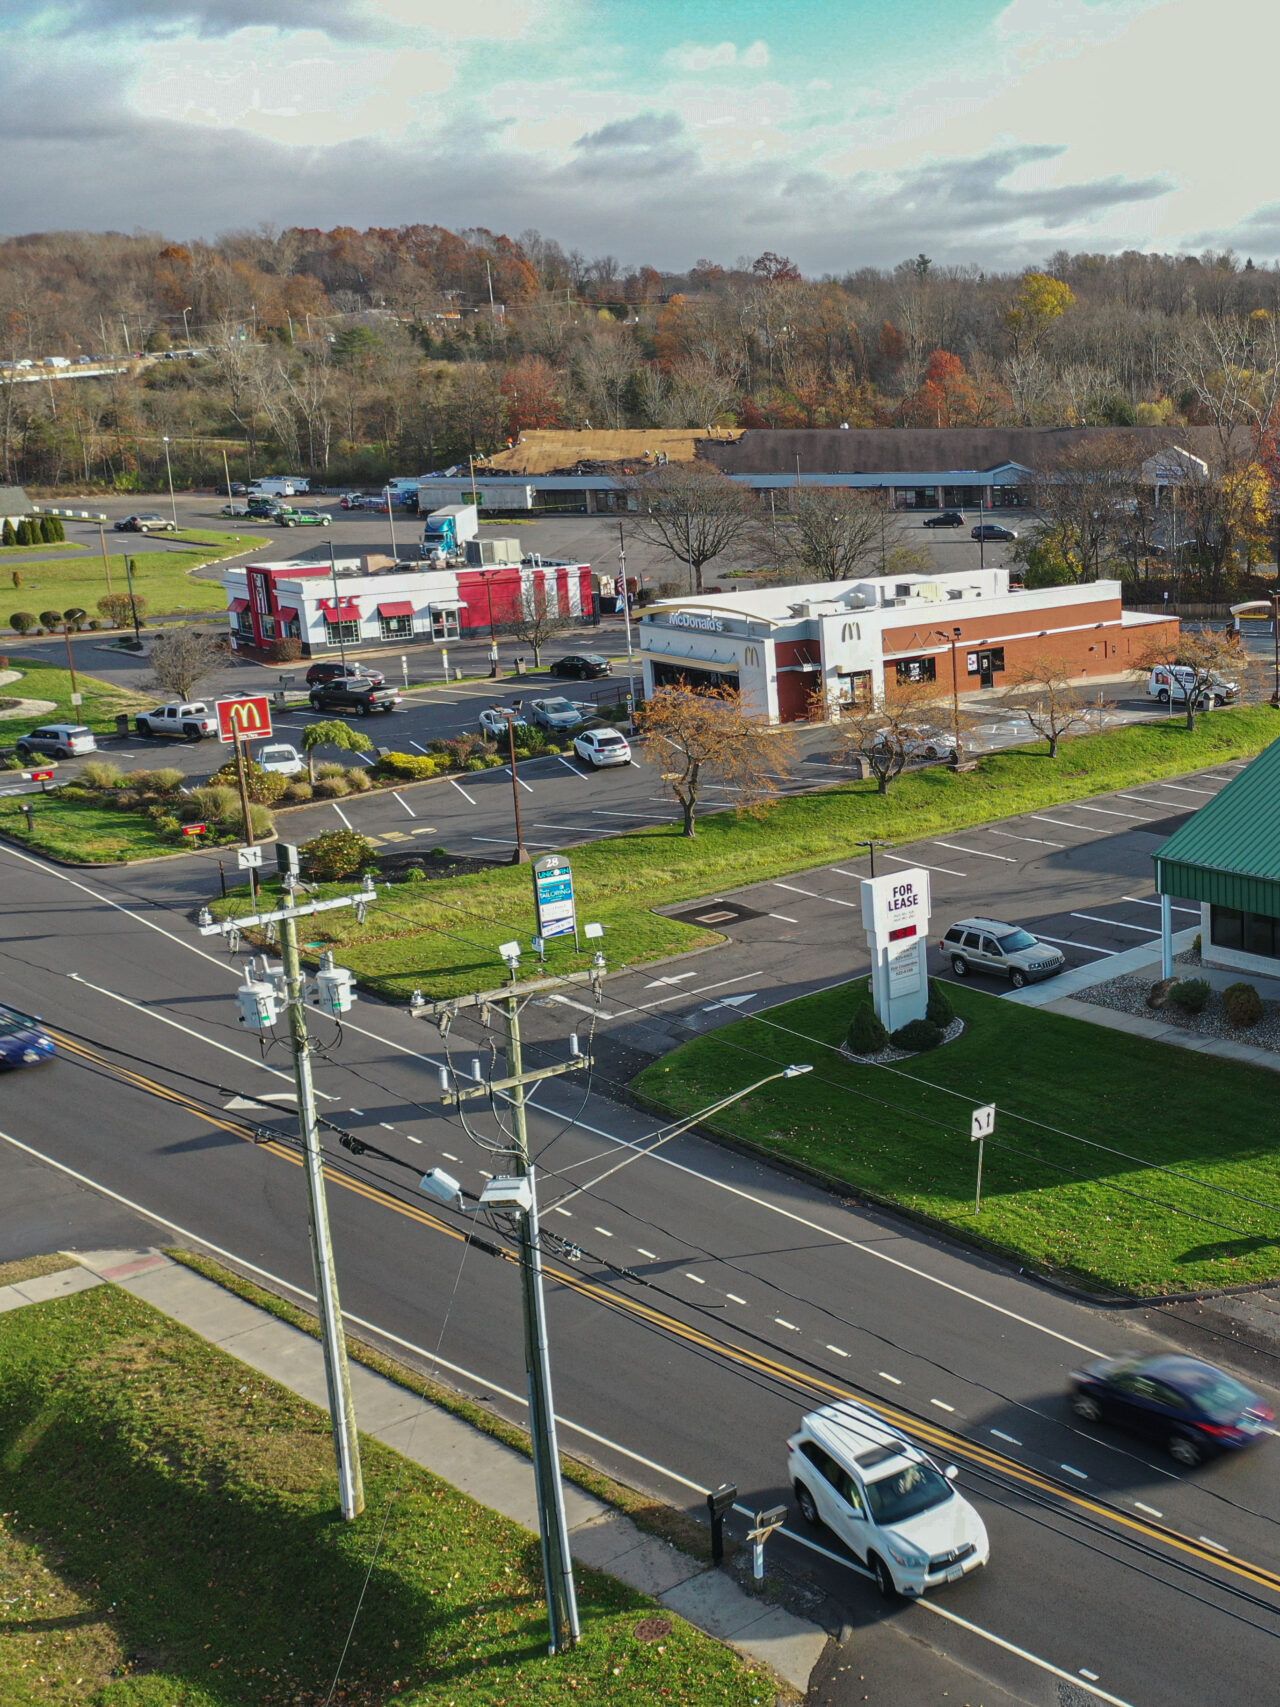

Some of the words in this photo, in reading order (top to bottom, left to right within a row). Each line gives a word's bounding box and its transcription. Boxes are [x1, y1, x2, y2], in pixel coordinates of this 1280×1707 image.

[317, 595, 361, 610] KFC
[669, 613, 723, 631] McDonald's
[545, 857, 559, 868] 28
[893, 883, 913, 898] FOR
[888, 894, 919, 912] LEASE
